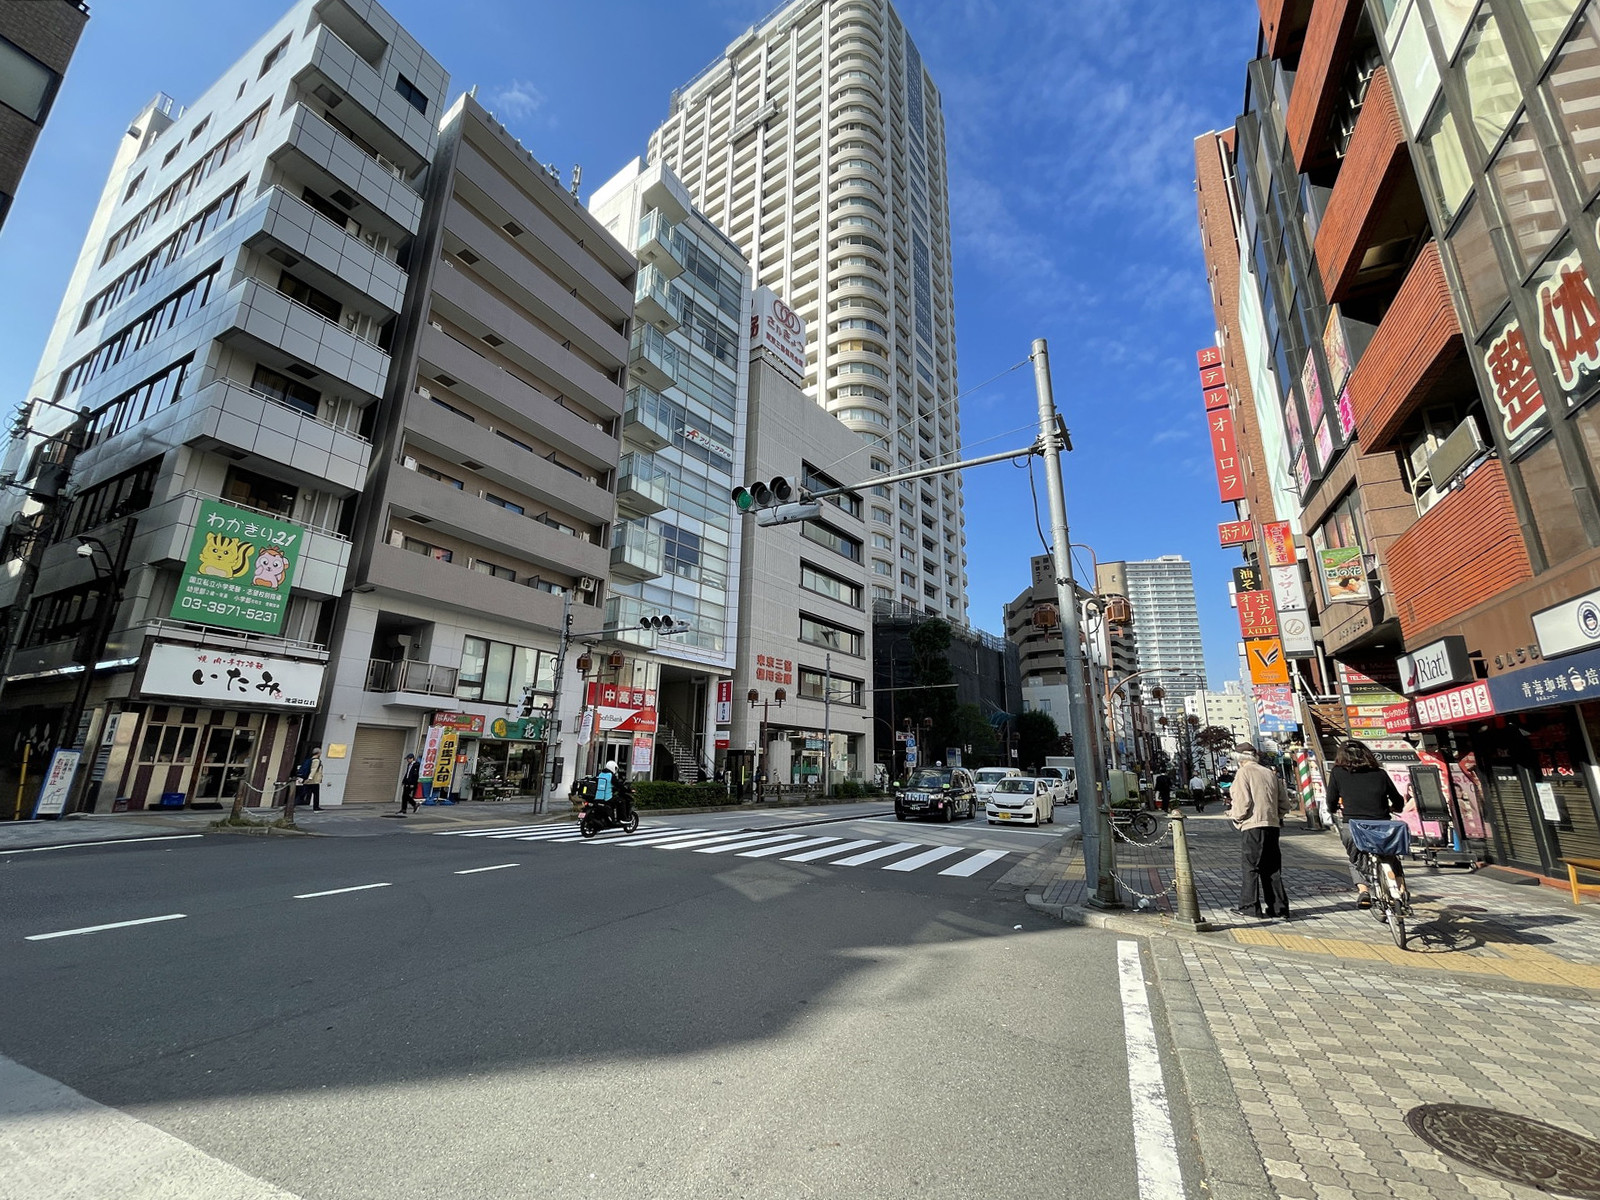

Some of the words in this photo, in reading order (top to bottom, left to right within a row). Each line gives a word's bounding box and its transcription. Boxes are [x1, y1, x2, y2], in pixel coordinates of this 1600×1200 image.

[206, 512, 297, 547] わかぎり21
[1221, 524, 1250, 541] ホテル
[181, 597, 278, 623] 03-3971-5231
[1240, 594, 1256, 626] オーロラ
[1256, 593, 1273, 625] ホテル
[192, 667, 283, 696] いたみ
[756, 667, 792, 685] 信用金庫
[1417, 651, 1448, 683] Riat!
[1521, 674, 1568, 698] 青海珈琲
